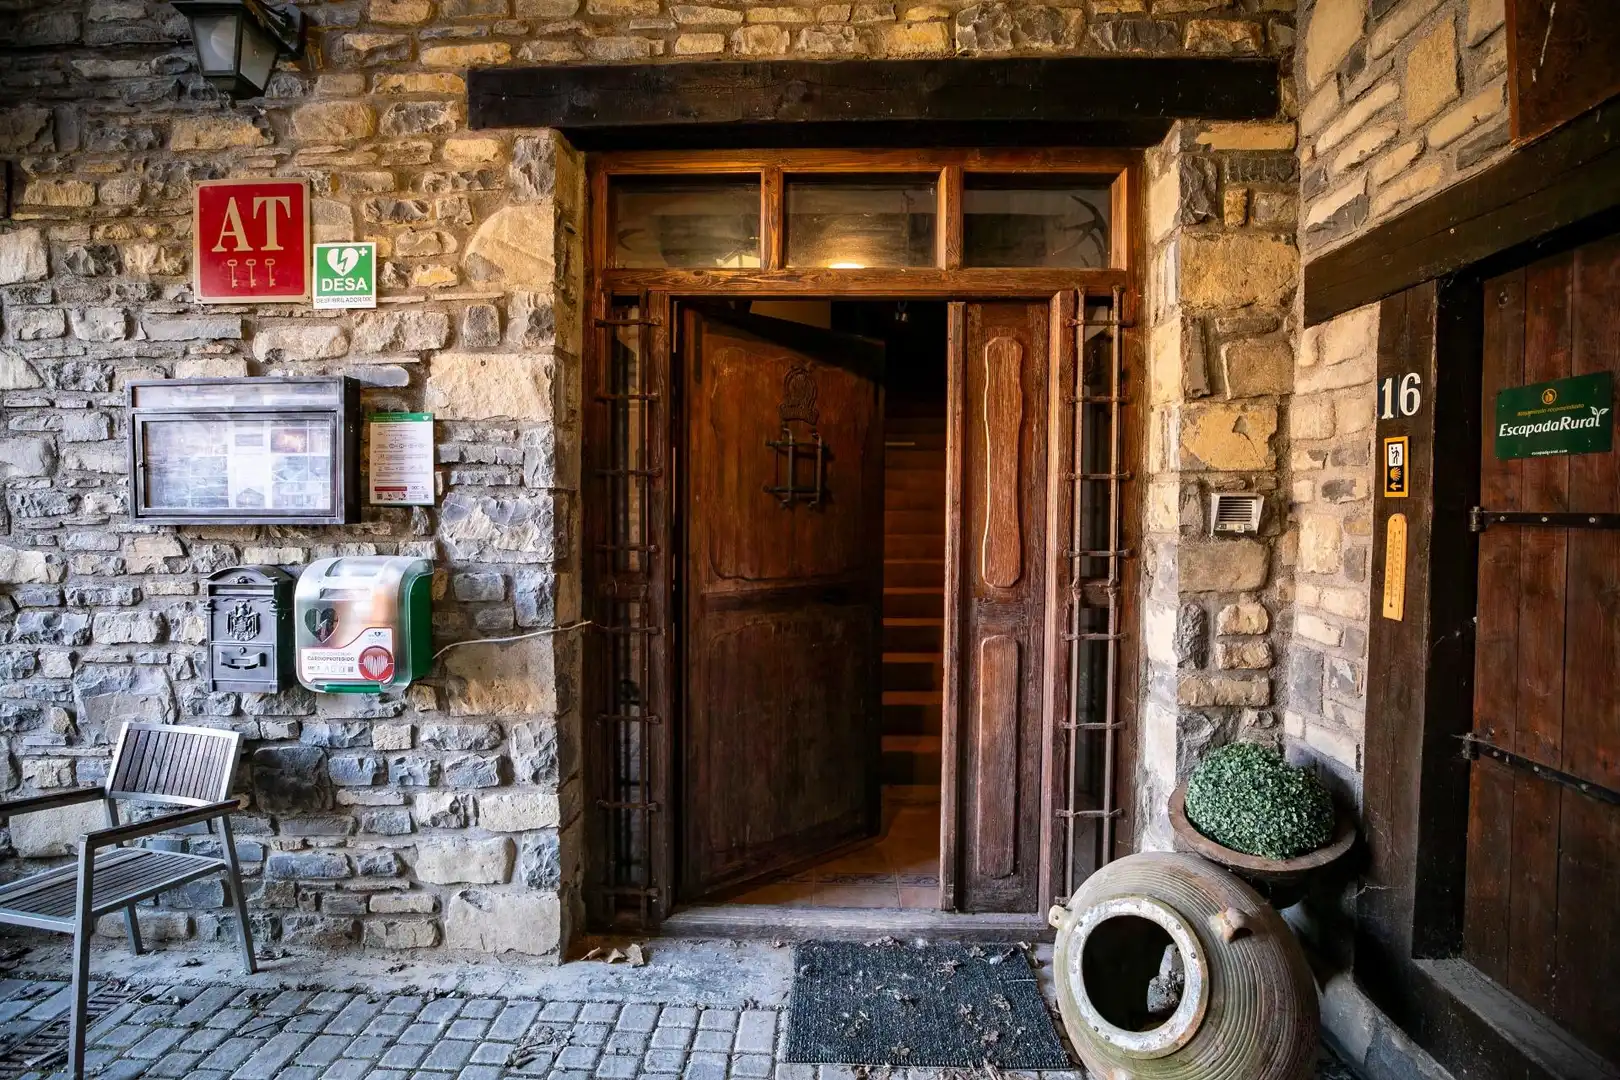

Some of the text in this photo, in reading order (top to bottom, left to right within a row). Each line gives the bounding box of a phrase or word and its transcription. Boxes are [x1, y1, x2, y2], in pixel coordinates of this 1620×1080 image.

[211, 196, 291, 252] AT
[321, 276, 368, 292] DESA
[1381, 372, 1421, 420] 16
[1499, 408, 1604, 438] EscapadaRural
